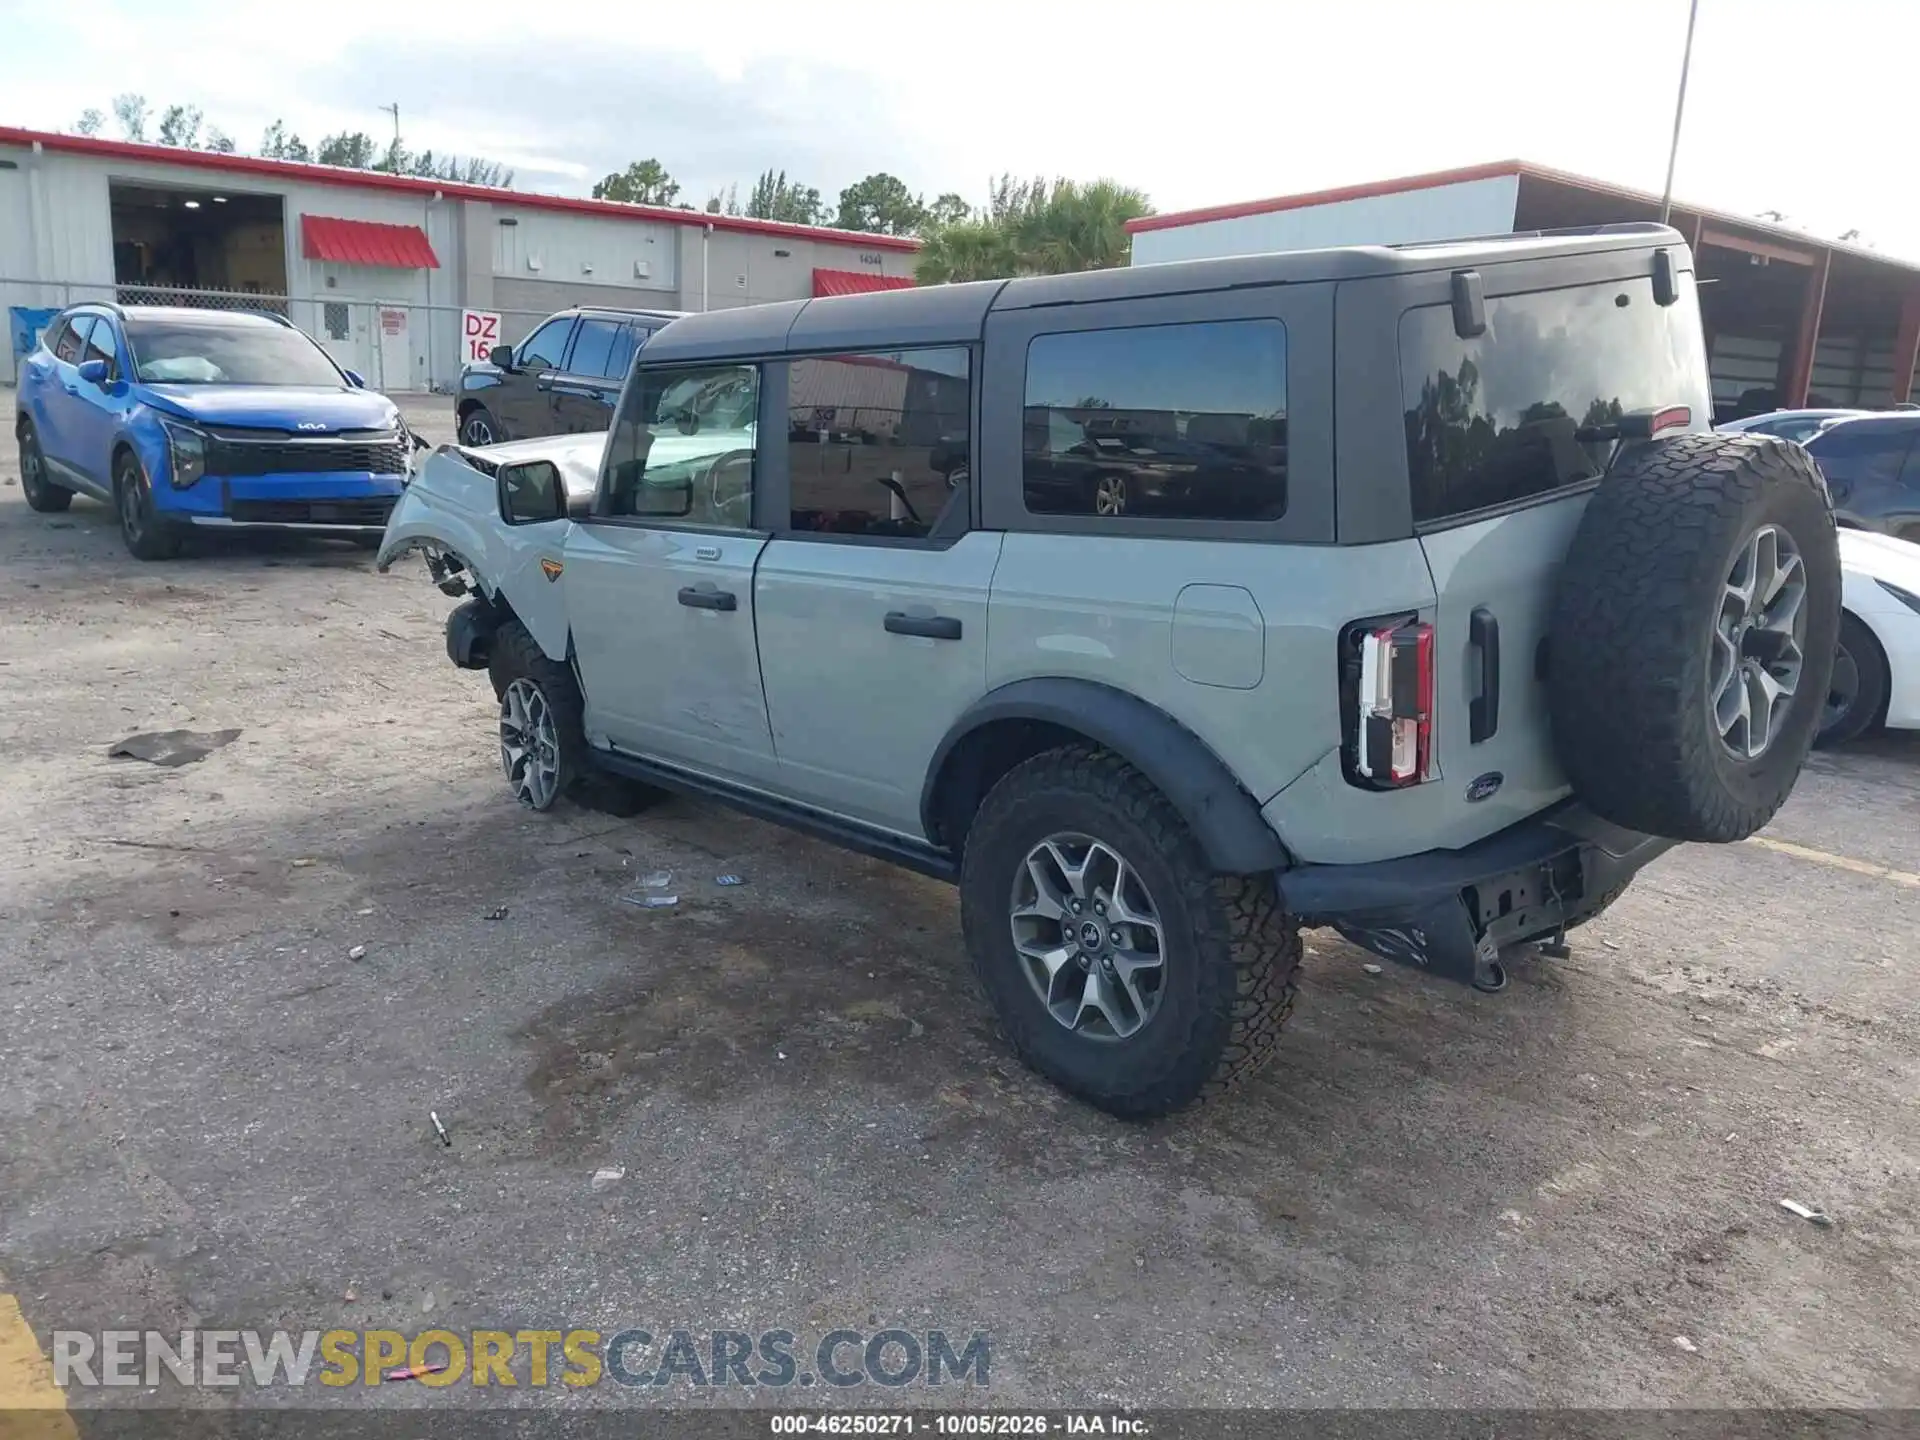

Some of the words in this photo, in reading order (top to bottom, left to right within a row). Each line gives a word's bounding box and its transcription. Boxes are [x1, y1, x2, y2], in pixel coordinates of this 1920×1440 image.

[466, 314, 497, 338] DZ
[470, 340, 489, 360] 16
[297, 422, 327, 430] KIA
